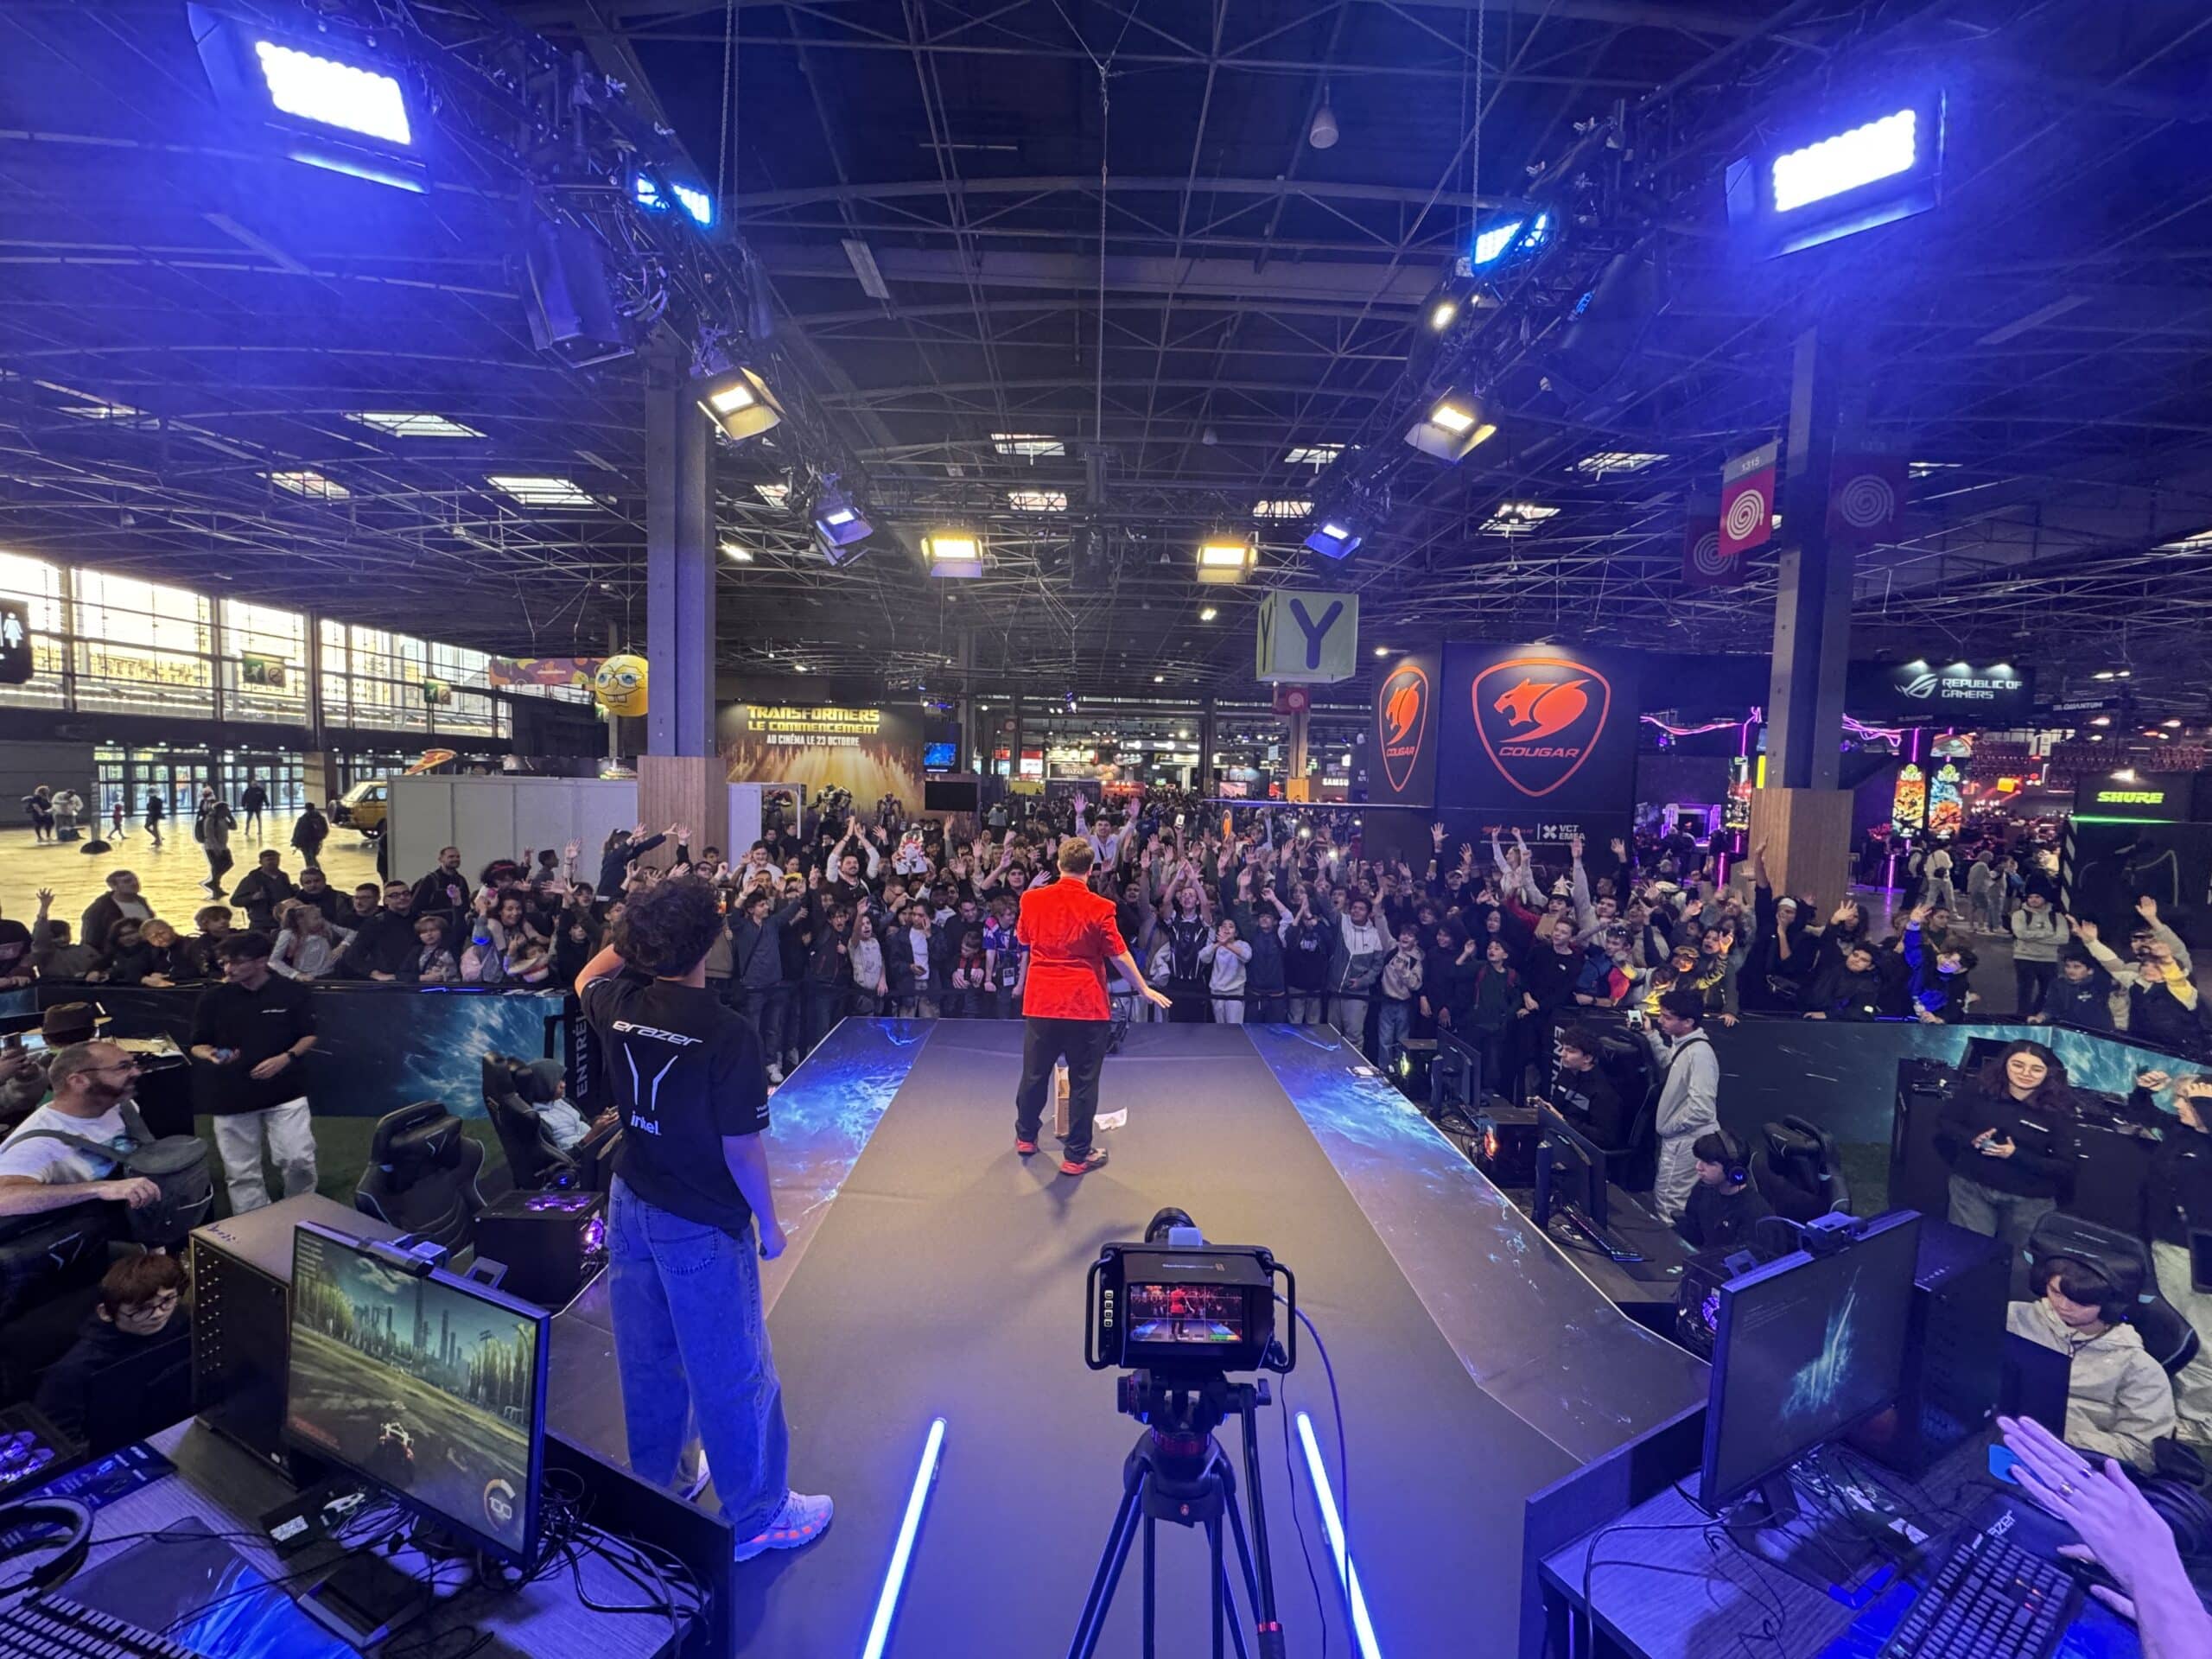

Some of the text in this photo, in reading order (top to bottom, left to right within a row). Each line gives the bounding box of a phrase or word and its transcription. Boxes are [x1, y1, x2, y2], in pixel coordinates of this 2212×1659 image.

[1289, 598, 1344, 670] Y
[1942, 677, 2022, 690] REPUBLIC OF
[1942, 690, 1993, 699] GAMERS
[747, 705, 880, 721] TRANSFORMERS
[748, 721, 880, 734] LE COMMENCEMENT
[766, 734, 860, 746] AU CINÉMA LE 23 OCTOBRE
[1386, 746, 1415, 757] COUGAR
[1499, 747, 1580, 758] COUGAR
[1322, 778, 1349, 786] SAMSU
[2097, 791, 2164, 804] SHURE
[612, 1020, 703, 1046] erazer
